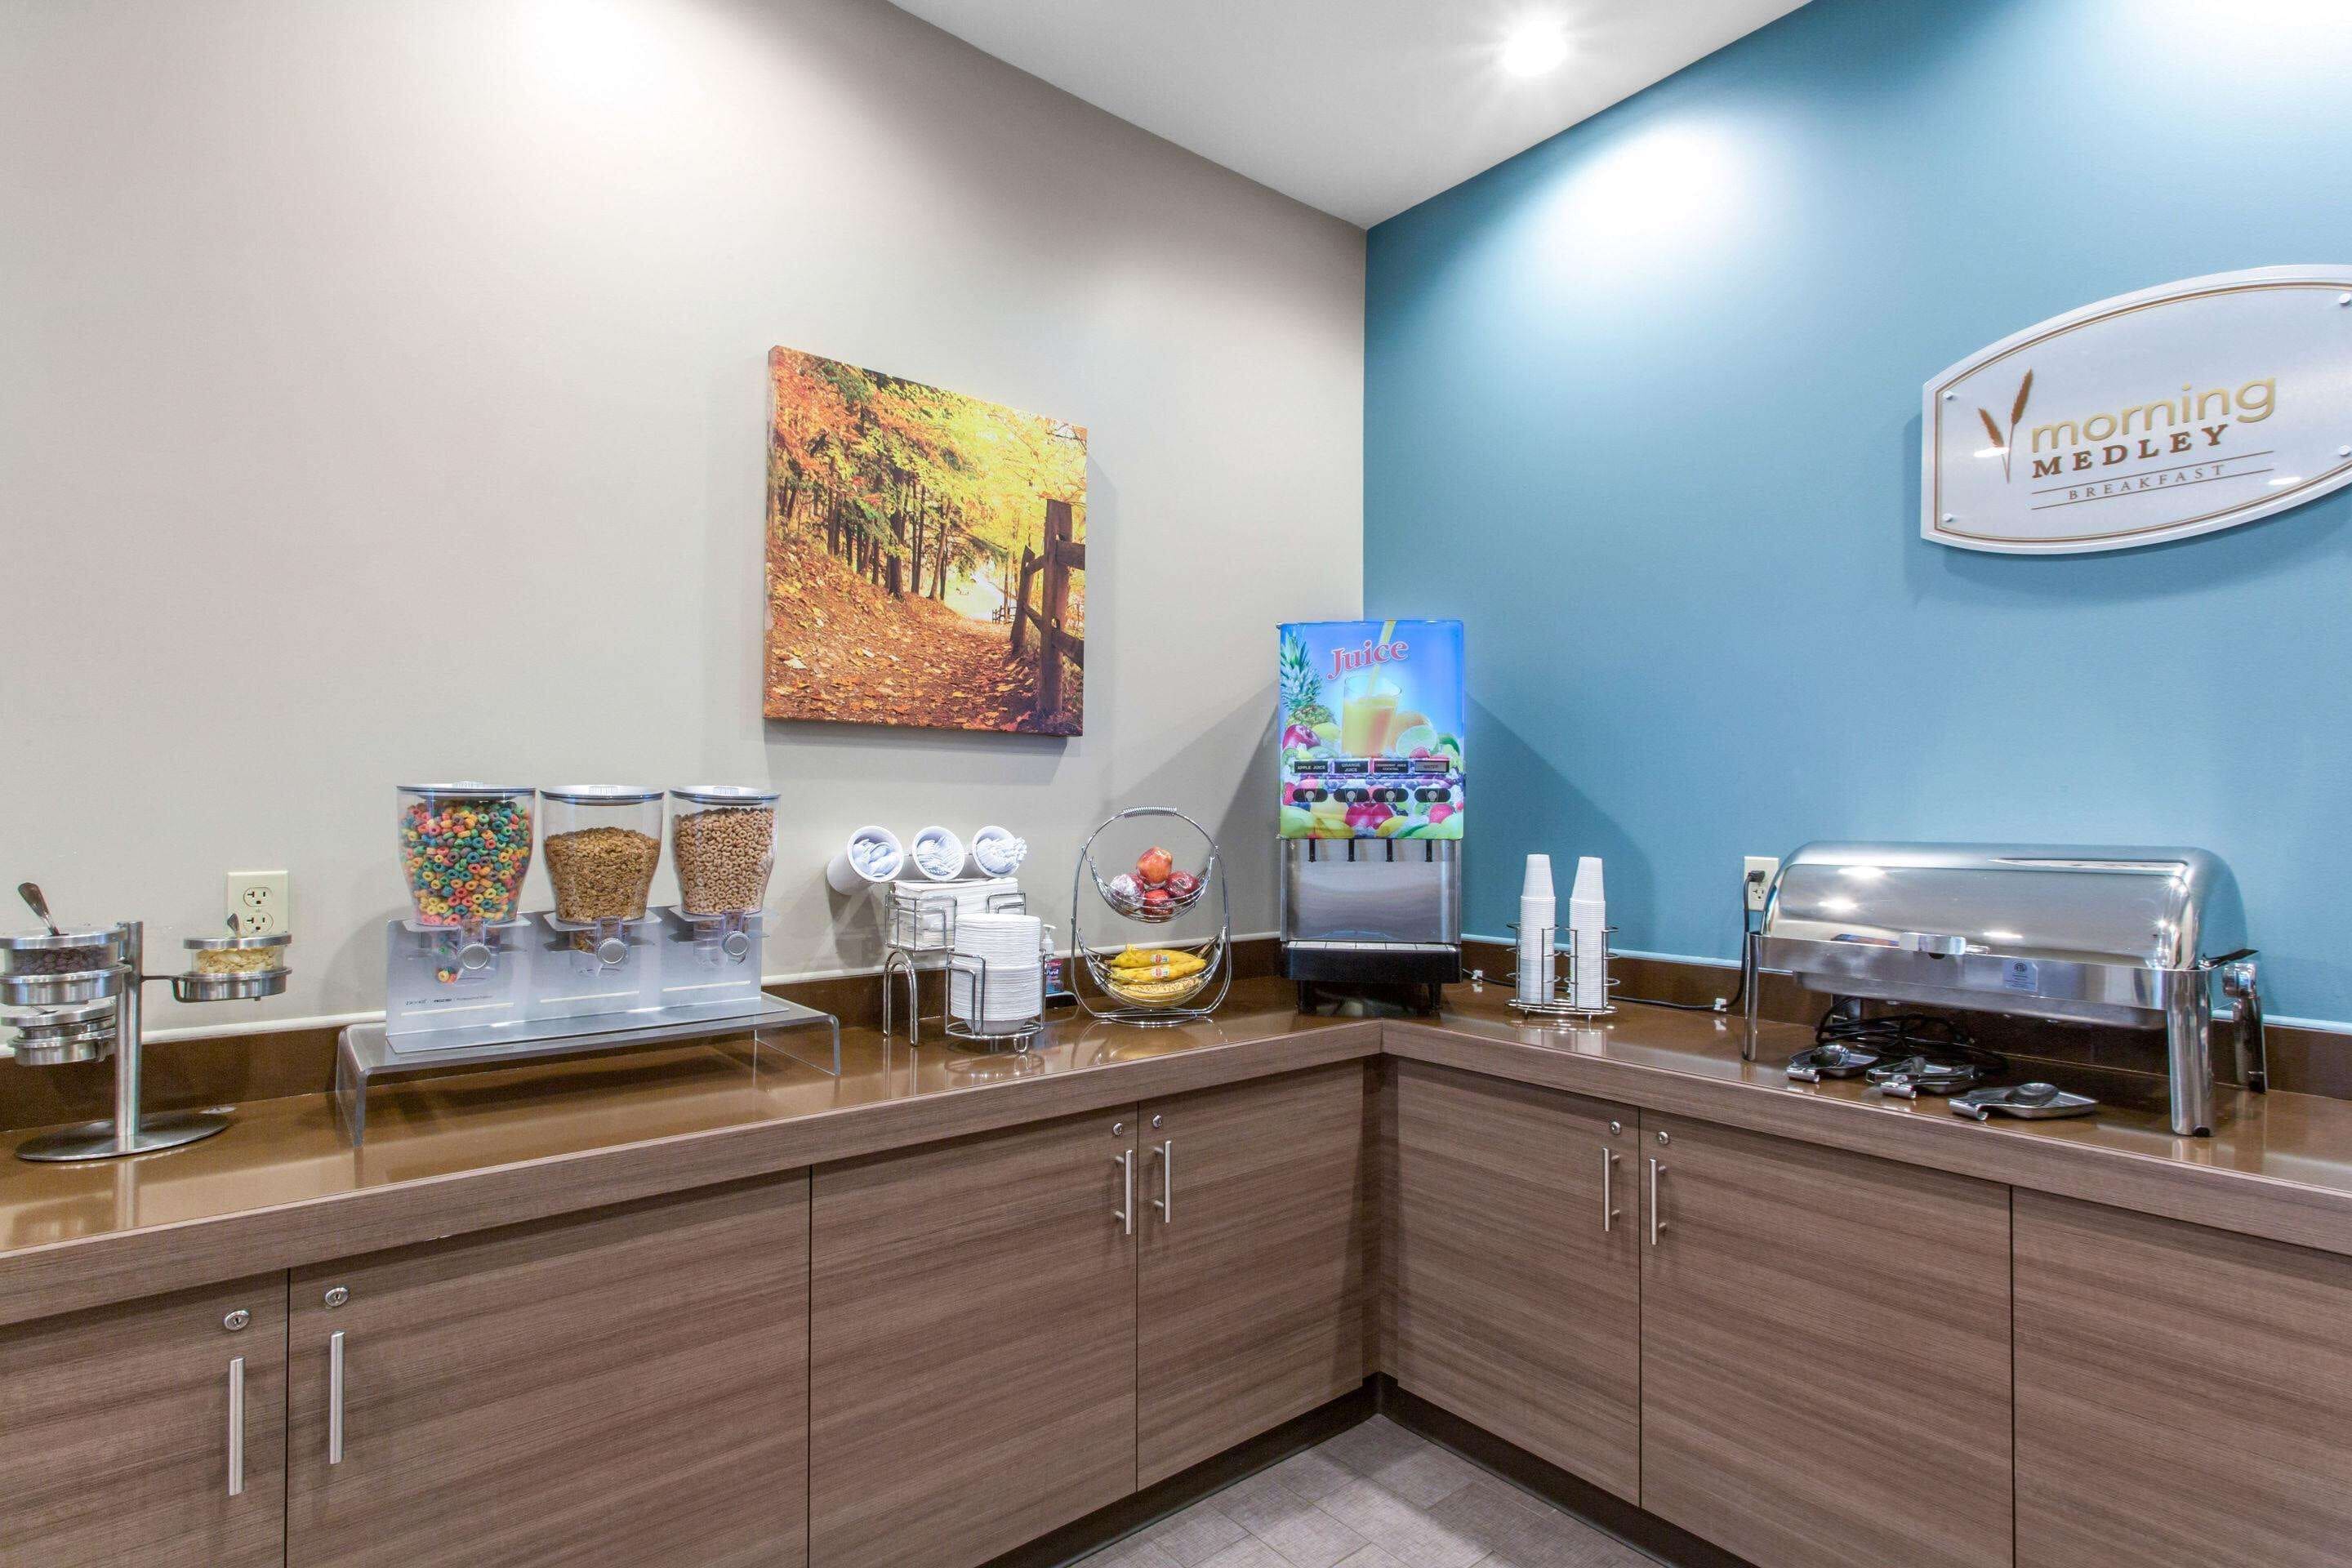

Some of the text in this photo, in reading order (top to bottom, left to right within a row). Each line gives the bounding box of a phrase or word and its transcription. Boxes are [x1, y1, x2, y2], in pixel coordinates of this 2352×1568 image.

[2031, 376, 2275, 453] morning
[2031, 423, 2230, 479] MEDLEY
[2068, 464, 2227, 501] BREAKFAST
[1326, 639, 1410, 680] Juice
